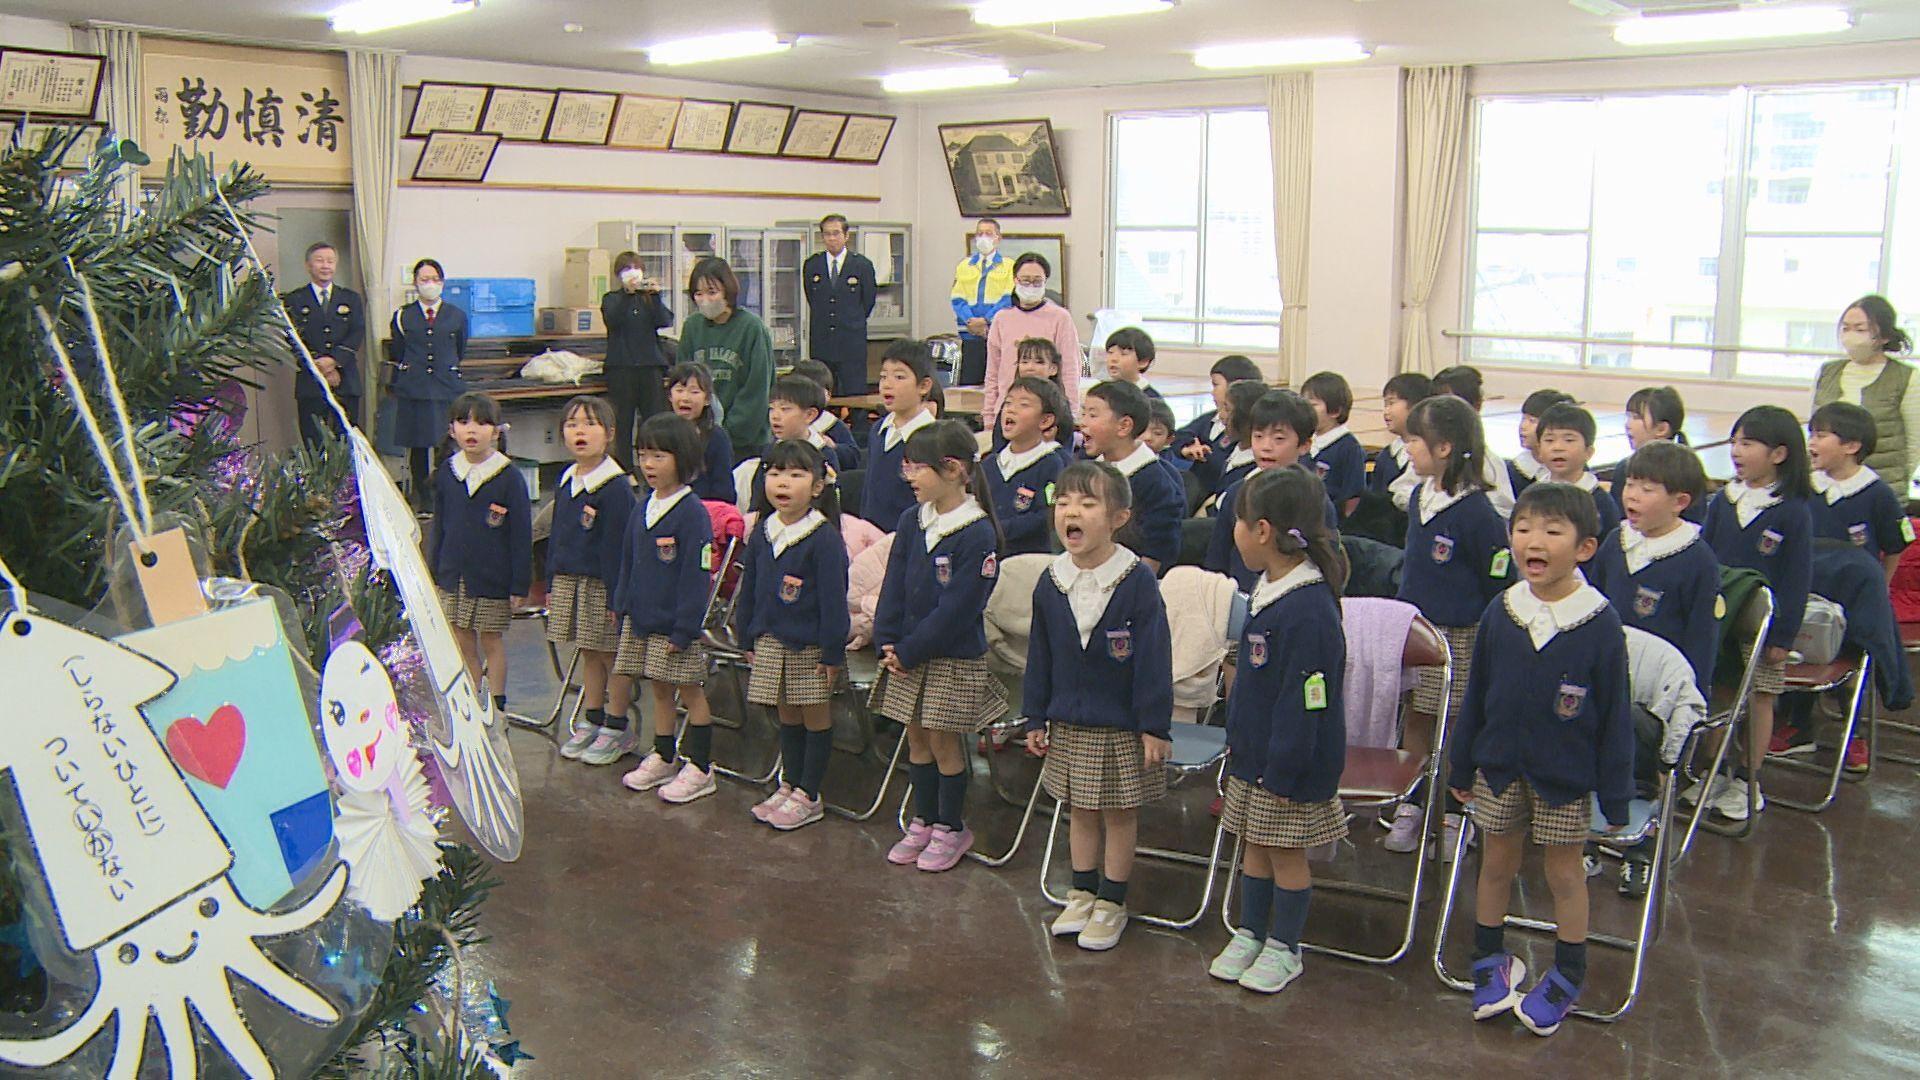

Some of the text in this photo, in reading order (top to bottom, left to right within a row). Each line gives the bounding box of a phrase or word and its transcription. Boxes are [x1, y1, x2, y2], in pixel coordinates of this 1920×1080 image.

[44, 737, 134, 902] ついていかない
